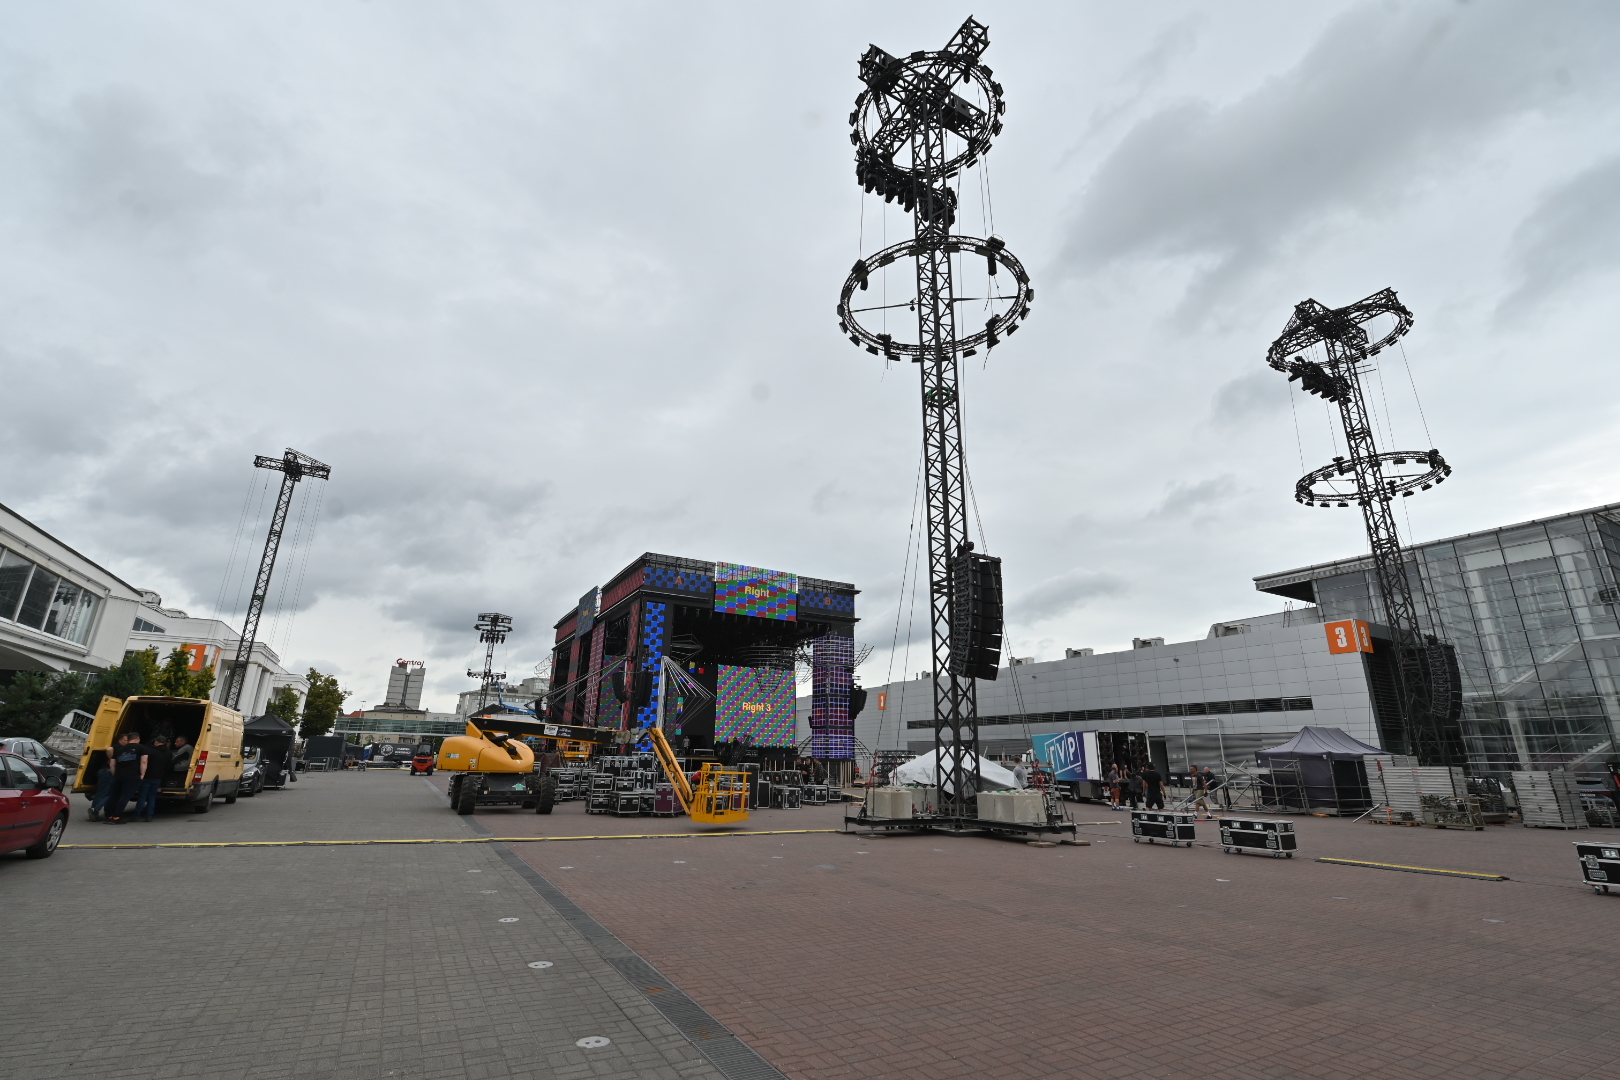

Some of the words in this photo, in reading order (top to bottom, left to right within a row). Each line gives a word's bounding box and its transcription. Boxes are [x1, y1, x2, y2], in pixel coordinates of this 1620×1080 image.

[744, 585, 770, 598] Right
[1335, 626, 1348, 648] 3
[1360, 626, 1369, 647] 3
[742, 701, 765, 714] Right
[765, 703, 772, 712] 3
[1046, 736, 1076, 769] TVP
